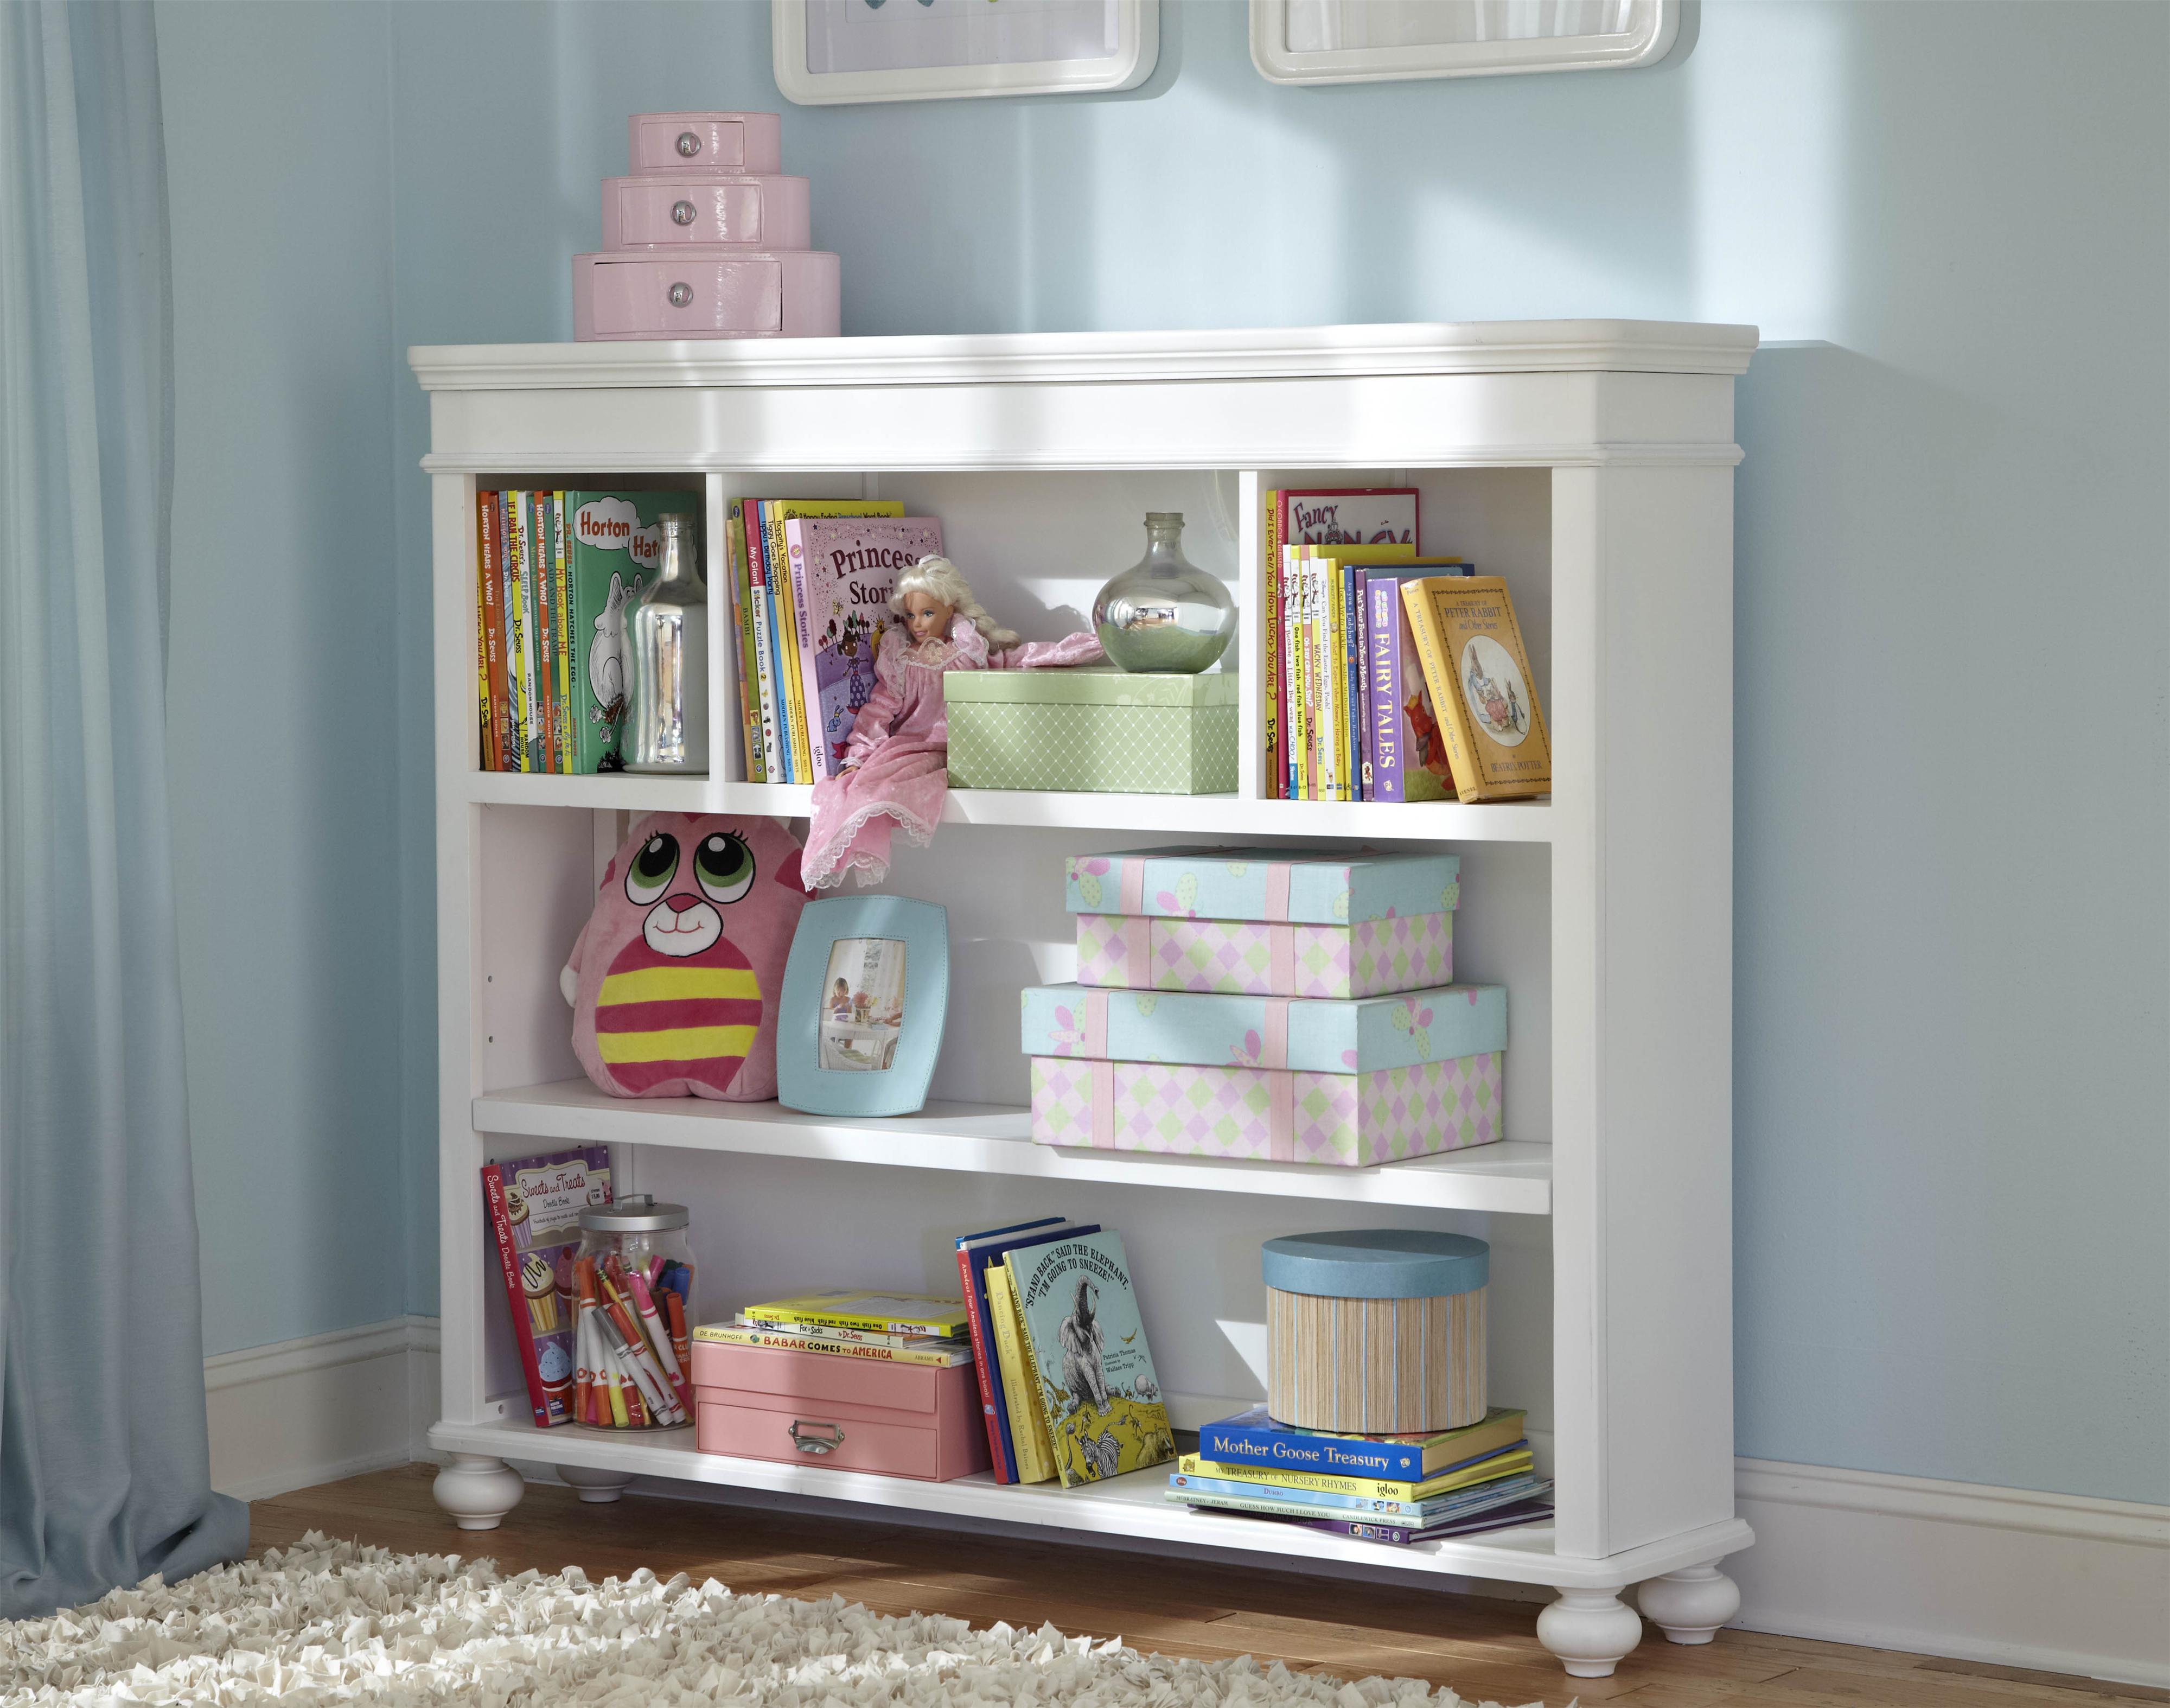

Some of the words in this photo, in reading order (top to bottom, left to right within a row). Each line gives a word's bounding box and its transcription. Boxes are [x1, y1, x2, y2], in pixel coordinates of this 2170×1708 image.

[537, 504, 545, 539] HORTON
[580, 511, 630, 538] Horton
[1293, 502, 1339, 533] Fancy
[510, 536, 518, 552] THE
[776, 520, 785, 551] Hoppity's
[482, 505, 490, 540] HORTON
[486, 580, 494, 606] WHO!
[749, 546, 757, 559] My
[510, 554, 520, 582] CIRCUS
[751, 561, 760, 585] Giant
[771, 563, 781, 596] Shopping
[540, 579, 548, 606] WHO!
[849, 578, 894, 605] Stori
[794, 563, 804, 609] Princess
[800, 610, 810, 649] Stories
[1444, 607, 1471, 617] PETER
[1471, 607, 1502, 617] RABBIT
[513, 619, 521, 632] Dr.
[515, 633, 524, 654] Seuss
[1375, 634, 1393, 696] FAIRY
[1267, 718, 1275, 730] Dr.
[1377, 700, 1395, 768] TALES
[1267, 731, 1275, 753] Seuss
[813, 745, 824, 767] igloo
[1490, 762, 1517, 773] BEATRIX
[1518, 760, 1542, 770] POTTER
[487, 1175, 499, 1204] Sweets
[521, 1179, 549, 1198] Sweets
[550, 1183, 560, 1193] and
[556, 1173, 585, 1191] Treats
[543, 1198, 558, 1209] Doodle
[558, 1196, 571, 1206] Book
[496, 1215, 508, 1244] Treats
[501, 1247, 511, 1270] Doodle
[506, 1271, 515, 1289] Book
[1025, 1273, 1041, 1309] "STAND
[1037, 1251, 1056, 1277] BACK,"
[1055, 1244, 1072, 1259] SAID
[1073, 1244, 1088, 1256] THE
[1090, 1248, 1129, 1290] ELEPHANT,
[1038, 1279, 1050, 1298] "I'M
[1047, 1261, 1067, 1283] GOING
[1067, 1258, 1077, 1270] TO
[1079, 1258, 1114, 1283] SNEEZE!"
[962, 1263, 970, 1293] Amadeus
[969, 1310, 978, 1338] Amadeus
[995, 1291, 1007, 1329] Dancing
[710, 1331, 743, 1341] BRUNHOFF
[763, 1336, 806, 1349] BABAR
[807, 1342, 841, 1353] COMES
[852, 1346, 893, 1359] AMERICA
[1103, 1352, 1119, 1360] Patricia
[1011, 1379, 1021, 1416] Illustrated
[1016, 1415, 1023, 1423] by
[1214, 1436, 1269, 1456] Mother
[1273, 1442, 1320, 1461] Goose
[1324, 1446, 1389, 1471] Treasury
[1226, 1467, 1269, 1481] TREASURY
[1281, 1474, 1320, 1488] NURSERY
[1322, 1478, 1357, 1491] RHYMES
[1377, 1482, 1399, 1497] igloo
[1342, 1514, 1377, 1522] CANDLEWICK
